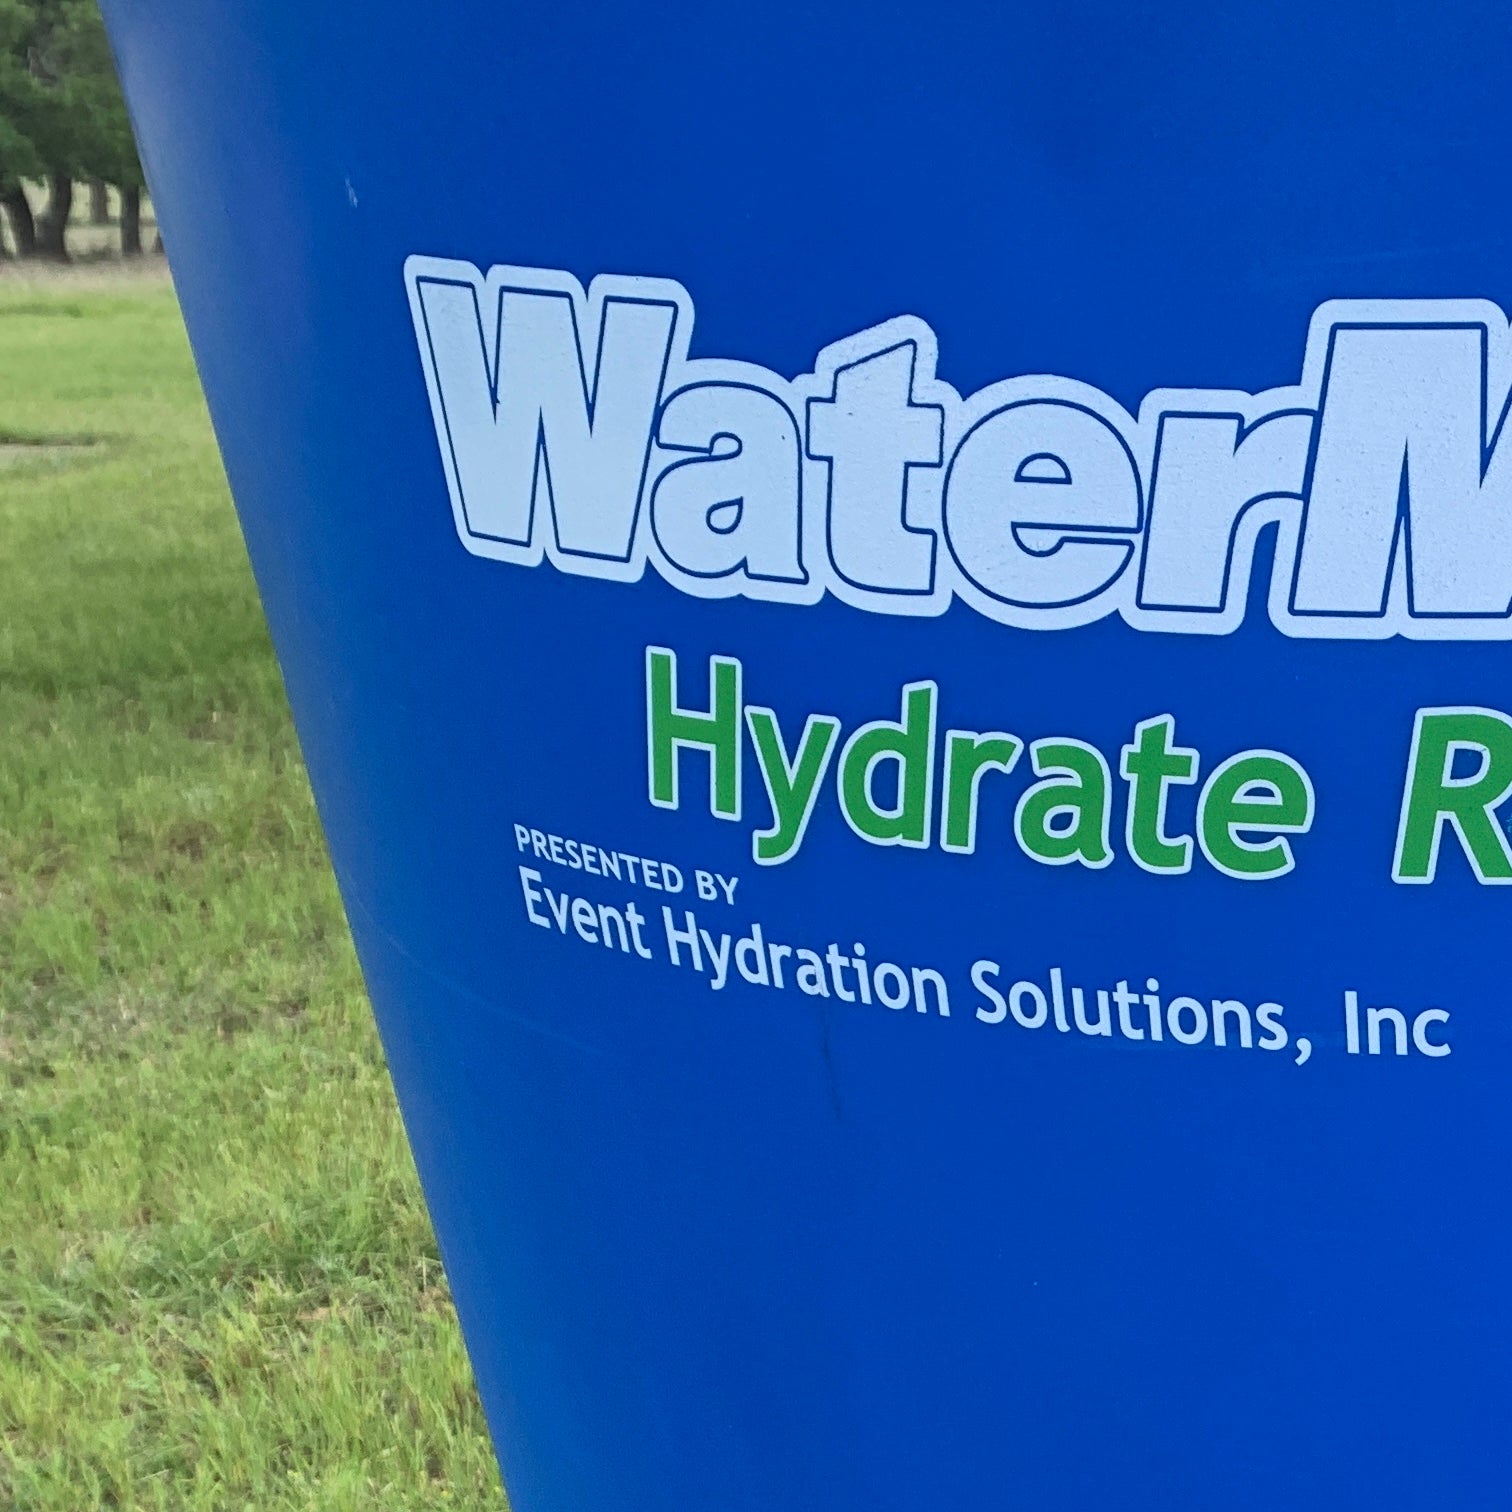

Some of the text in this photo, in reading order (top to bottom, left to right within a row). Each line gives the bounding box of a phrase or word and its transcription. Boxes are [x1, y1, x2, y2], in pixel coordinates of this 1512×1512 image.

[645, 645, 1316, 882] Hydrate
[514, 824, 739, 905] PRESENTED BY
[518, 865, 652, 959] Event
[661, 905, 951, 1017] Hydration
[970, 959, 1312, 1066] Solutions,
[1344, 990, 1451, 1059] Inc
